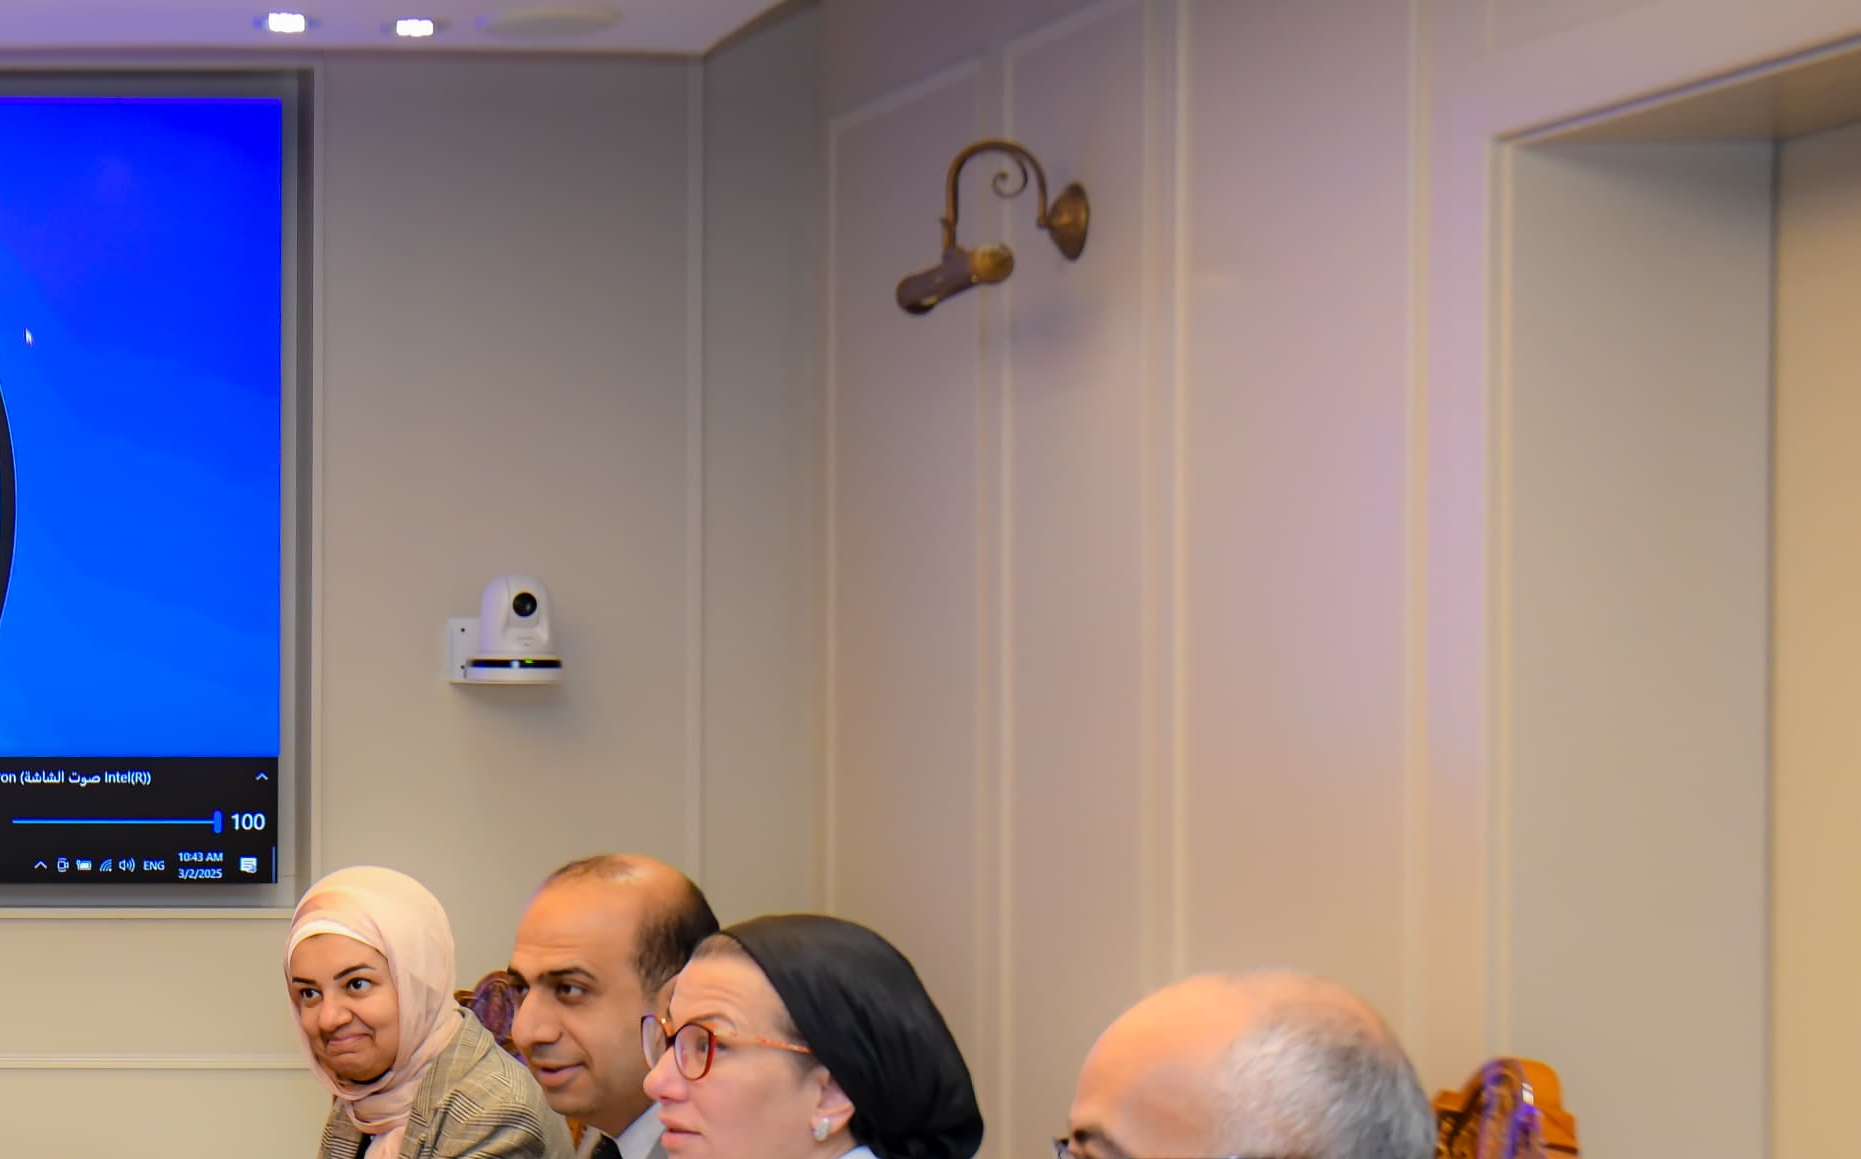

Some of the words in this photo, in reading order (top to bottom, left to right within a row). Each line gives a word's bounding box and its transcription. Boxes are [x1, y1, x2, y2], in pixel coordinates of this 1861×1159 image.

[231, 813, 266, 832] 100
[178, 852, 204, 863] 10:43
[207, 852, 223, 863] AM
[143, 860, 165, 871] ENG
[178, 868, 222, 880] 3/2/2025
